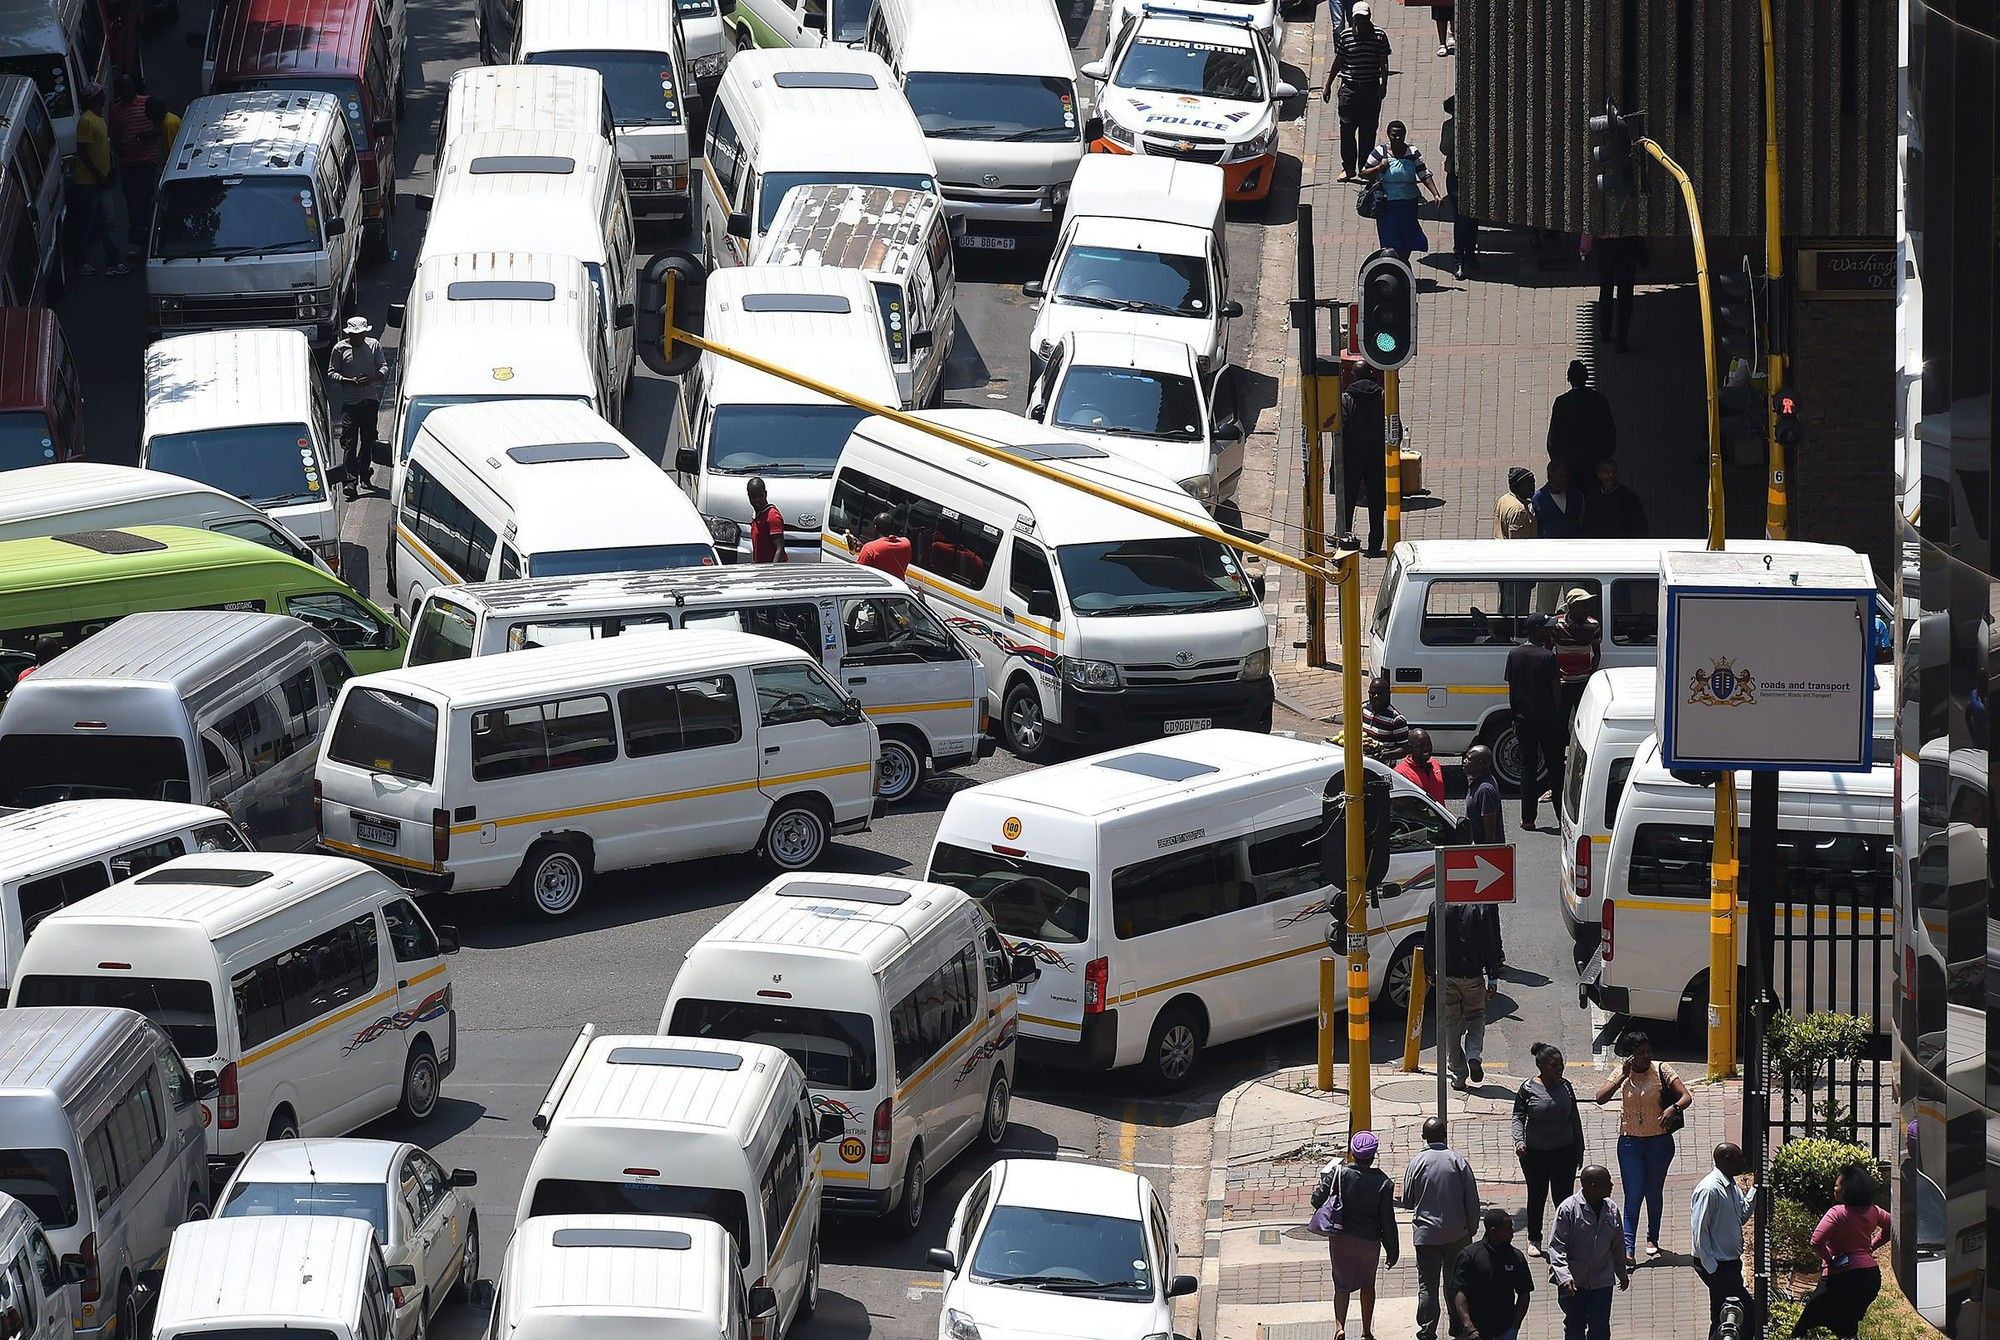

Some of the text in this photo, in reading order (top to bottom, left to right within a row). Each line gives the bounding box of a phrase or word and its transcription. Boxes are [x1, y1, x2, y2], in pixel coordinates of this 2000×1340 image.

[1146, 115, 1230, 132] POLICE
[1775, 471, 1783, 482] 6
[1760, 681, 1850, 691] roads and transport
[1007, 822, 1019, 832] 100
[844, 1144, 862, 1156] 100
